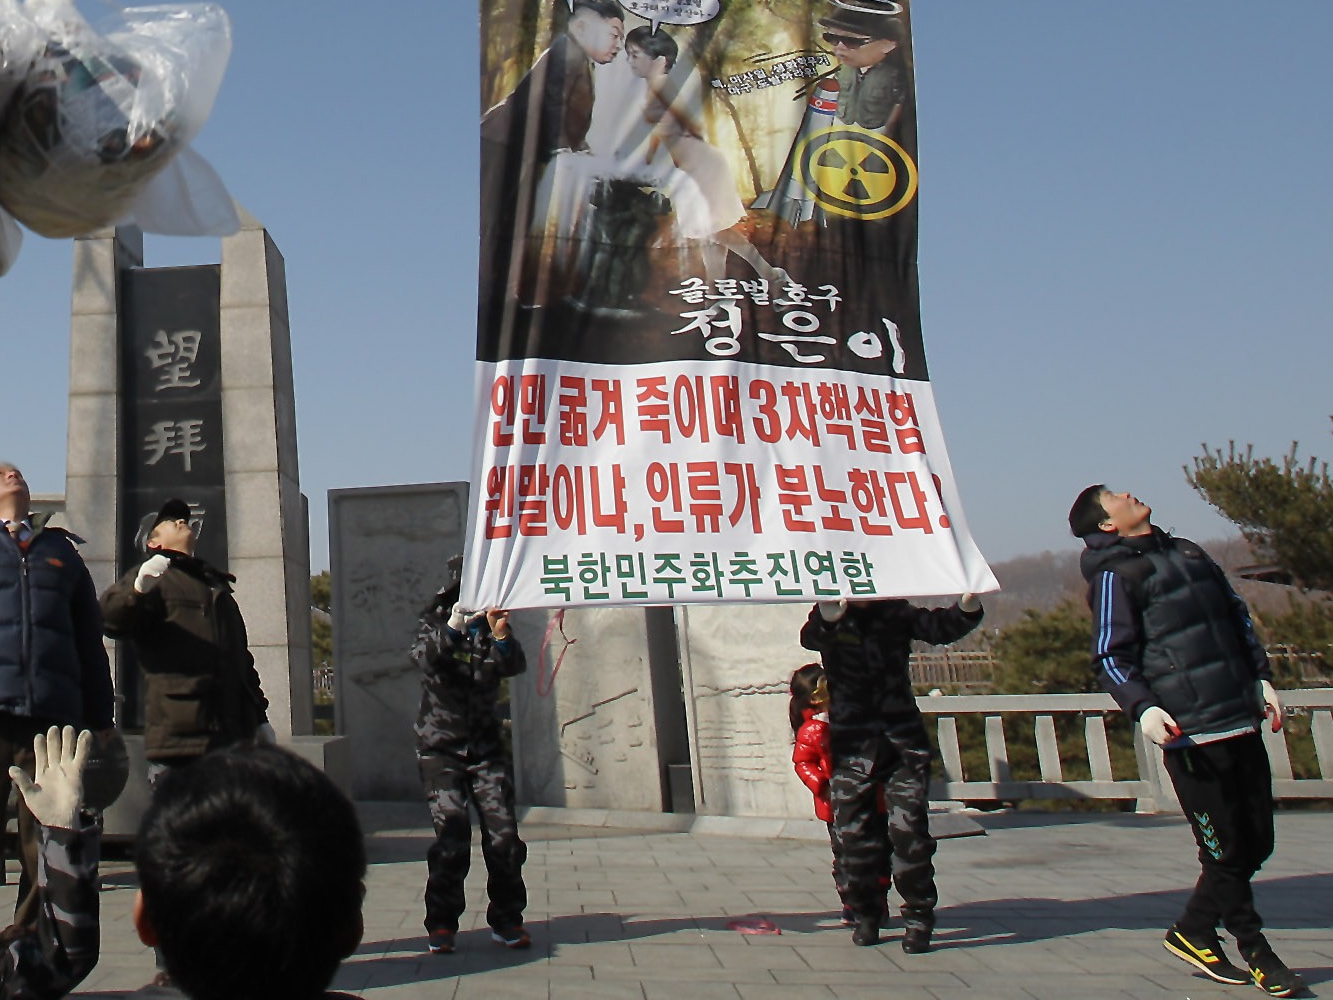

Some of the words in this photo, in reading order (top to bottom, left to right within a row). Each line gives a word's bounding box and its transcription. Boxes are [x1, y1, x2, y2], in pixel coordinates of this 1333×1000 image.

[669, 277, 770, 306] 글로벌
[773, 283, 843, 312] 호구
[670, 300, 906, 374] 정은이
[491, 374, 547, 447] 인민
[559, 376, 625, 447] 굶겨
[775, 463, 951, 536] 분노한다!
[539, 550, 878, 601] 북한민주화추진연합
